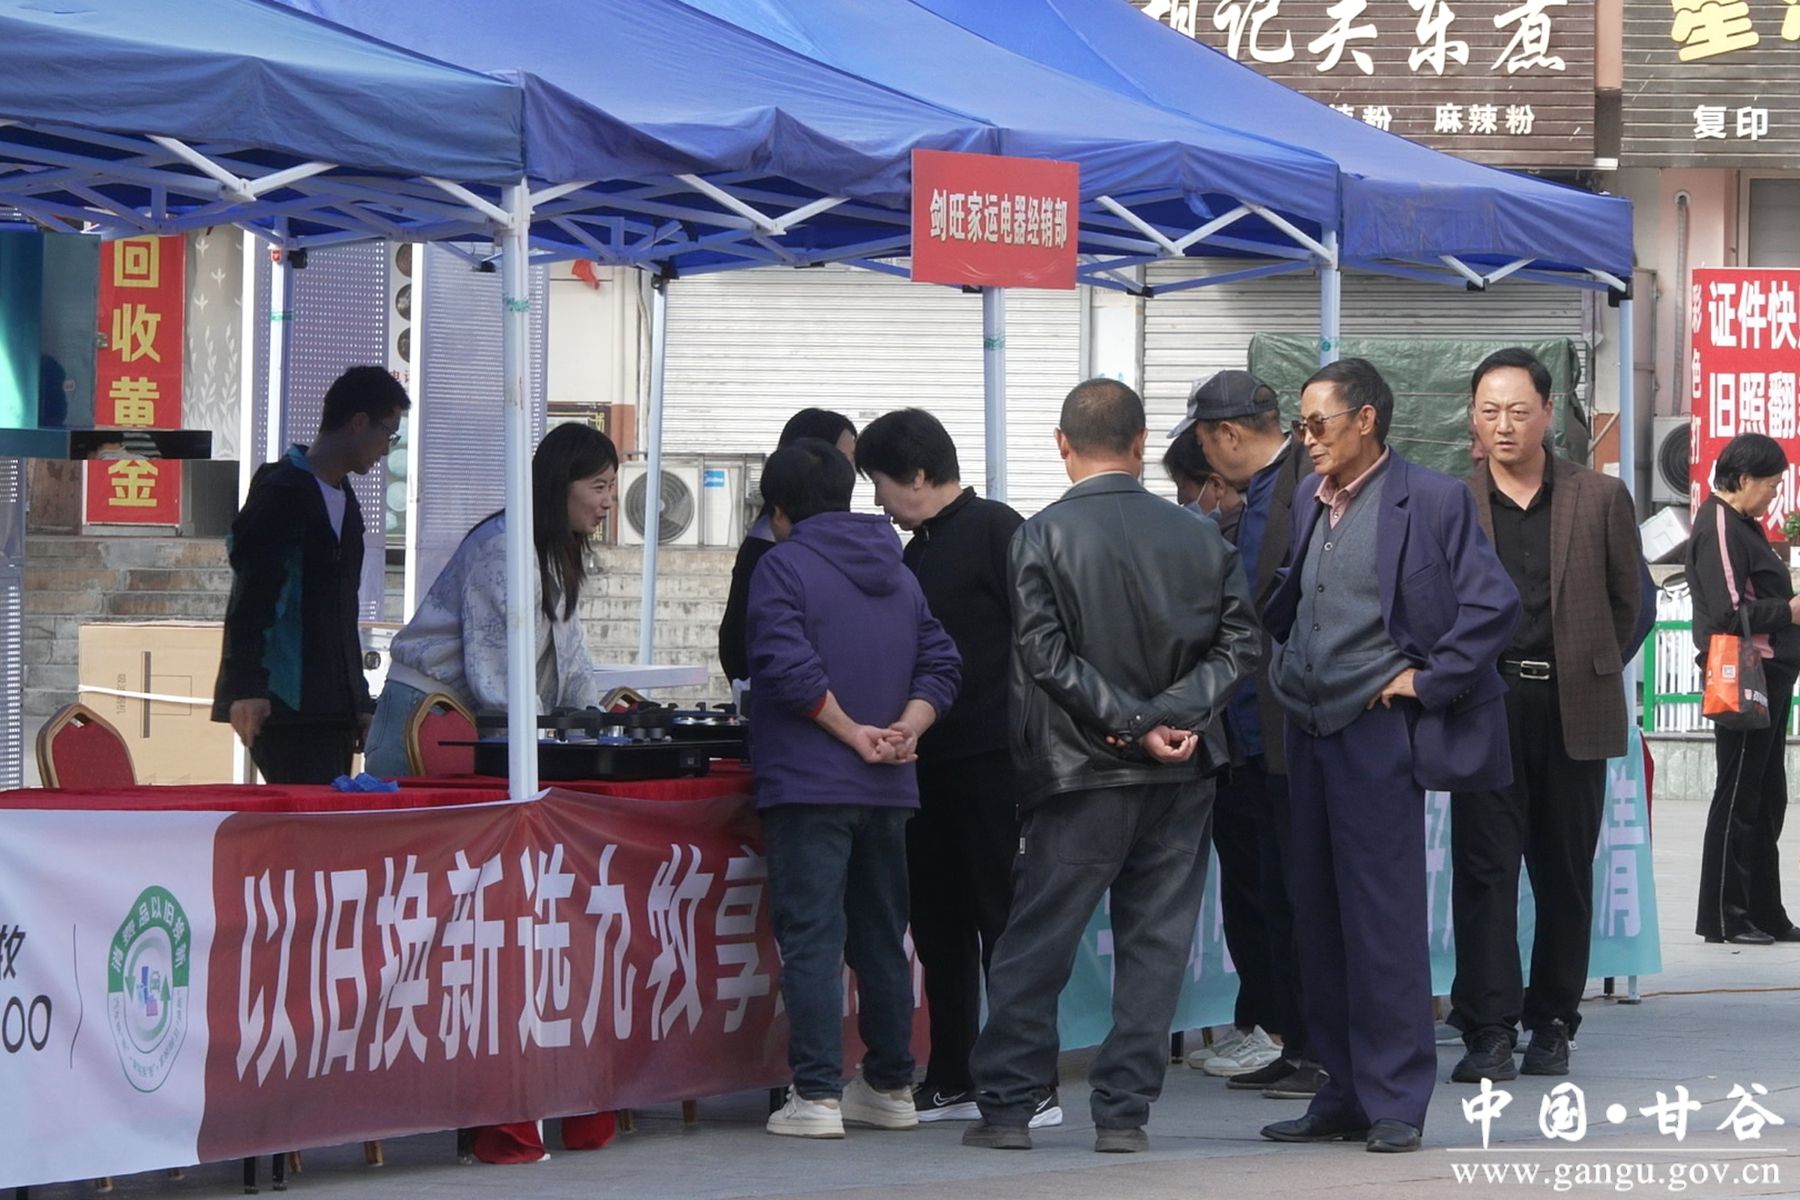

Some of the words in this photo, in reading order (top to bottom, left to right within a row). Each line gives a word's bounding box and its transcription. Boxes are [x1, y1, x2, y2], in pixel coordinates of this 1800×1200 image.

[1434, 103, 1535, 135] 麻辣粉
[1693, 105, 1768, 140] 复印
[930, 188, 1068, 248] 剑旺家运电器经销部
[1708, 280, 1800, 350] 证件快
[108, 235, 161, 507] 回收黄金
[1709, 371, 1800, 439] 旧照翻
[236, 842, 788, 1088] 以旧换新选九牧享
